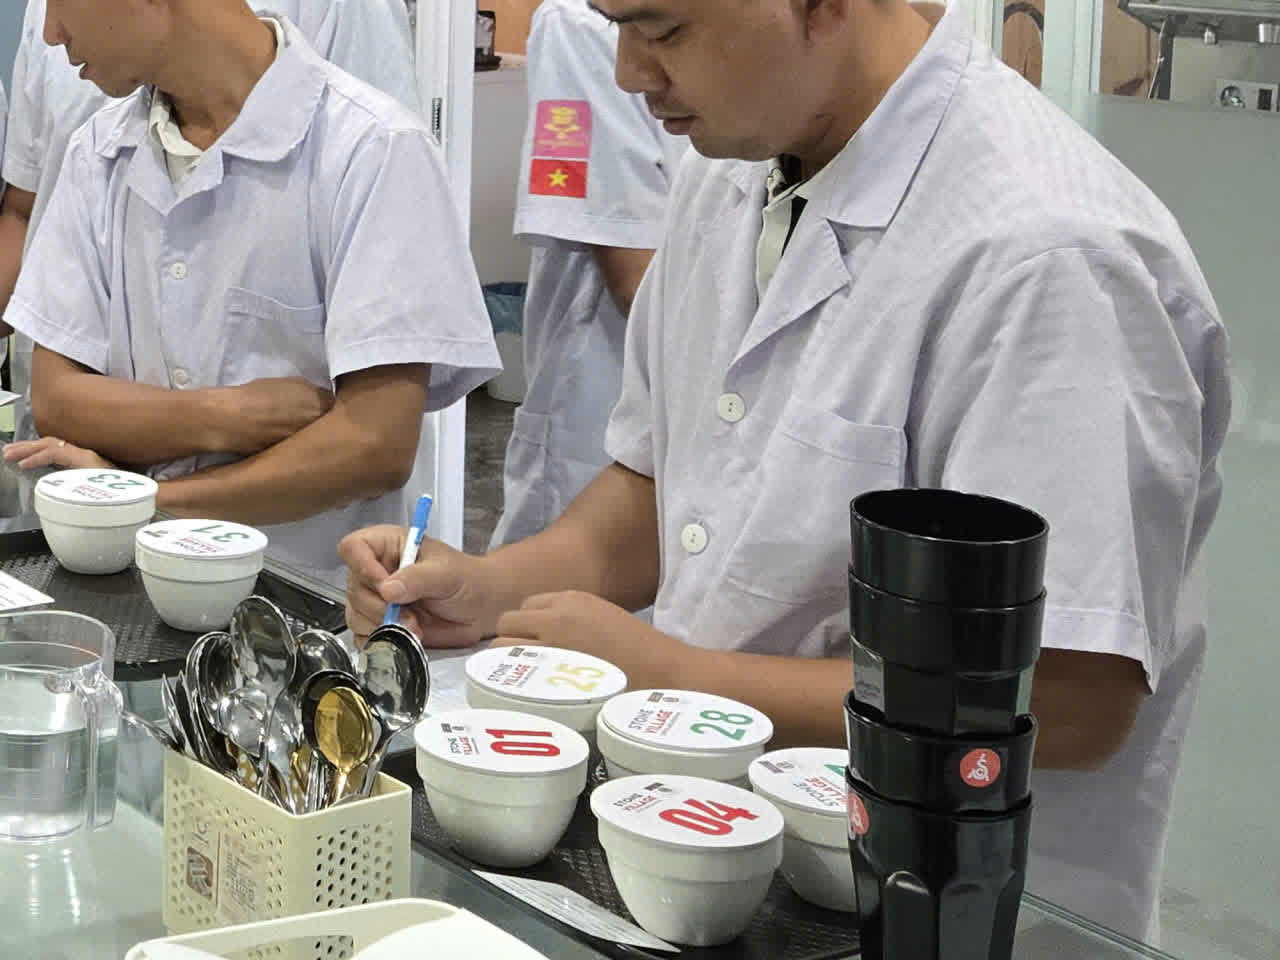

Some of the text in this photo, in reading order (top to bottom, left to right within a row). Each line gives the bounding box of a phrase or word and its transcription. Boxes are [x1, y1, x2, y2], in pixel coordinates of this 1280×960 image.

[87, 473, 145, 490] 23
[547, 662, 607, 693] 25
[629, 708, 653, 730] STONE
[643, 709, 674, 734] VILLAGE
[690, 709, 753, 741] 28
[485, 728, 561, 757] 01
[613, 793, 644, 808] STONE
[624, 795, 657, 812] VILLAGE
[793, 782, 839, 807] STONE
[659, 798, 760, 836] 04
